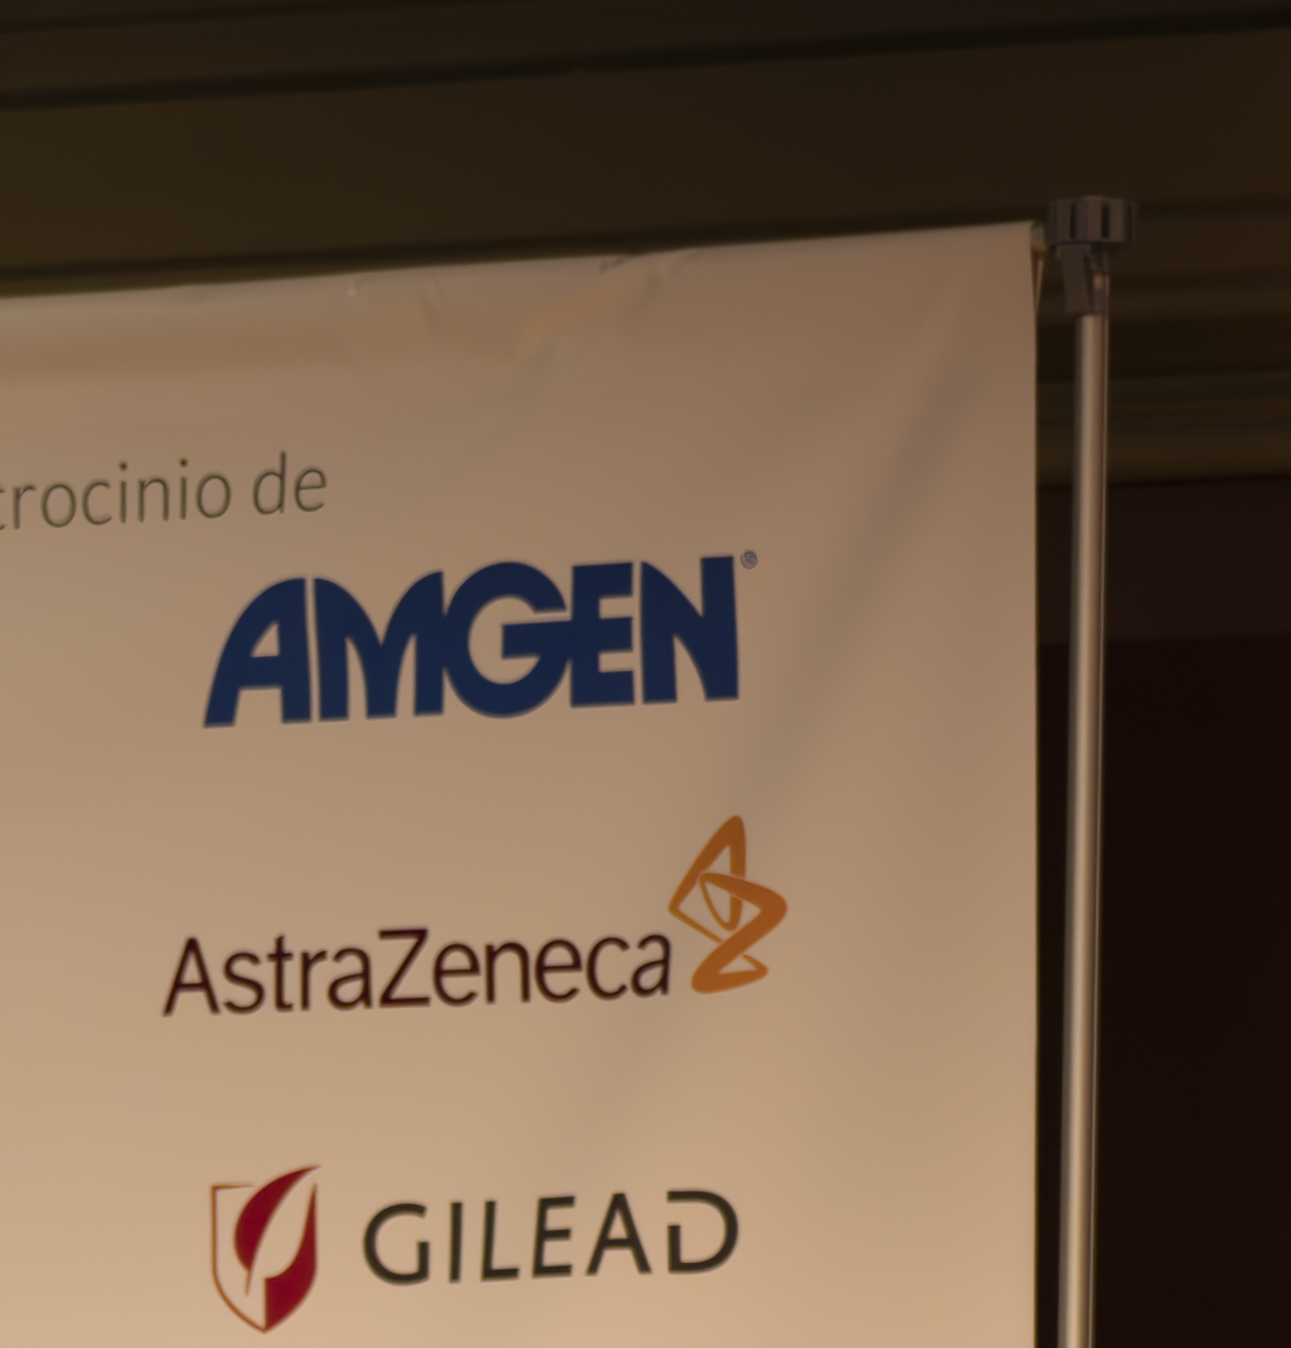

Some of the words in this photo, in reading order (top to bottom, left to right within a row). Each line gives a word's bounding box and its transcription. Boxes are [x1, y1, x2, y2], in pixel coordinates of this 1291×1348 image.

[252, 450, 328, 516] de
[162, 928, 672, 1017] AstraZeneca
[362, 1190, 740, 1285] GILEAD
